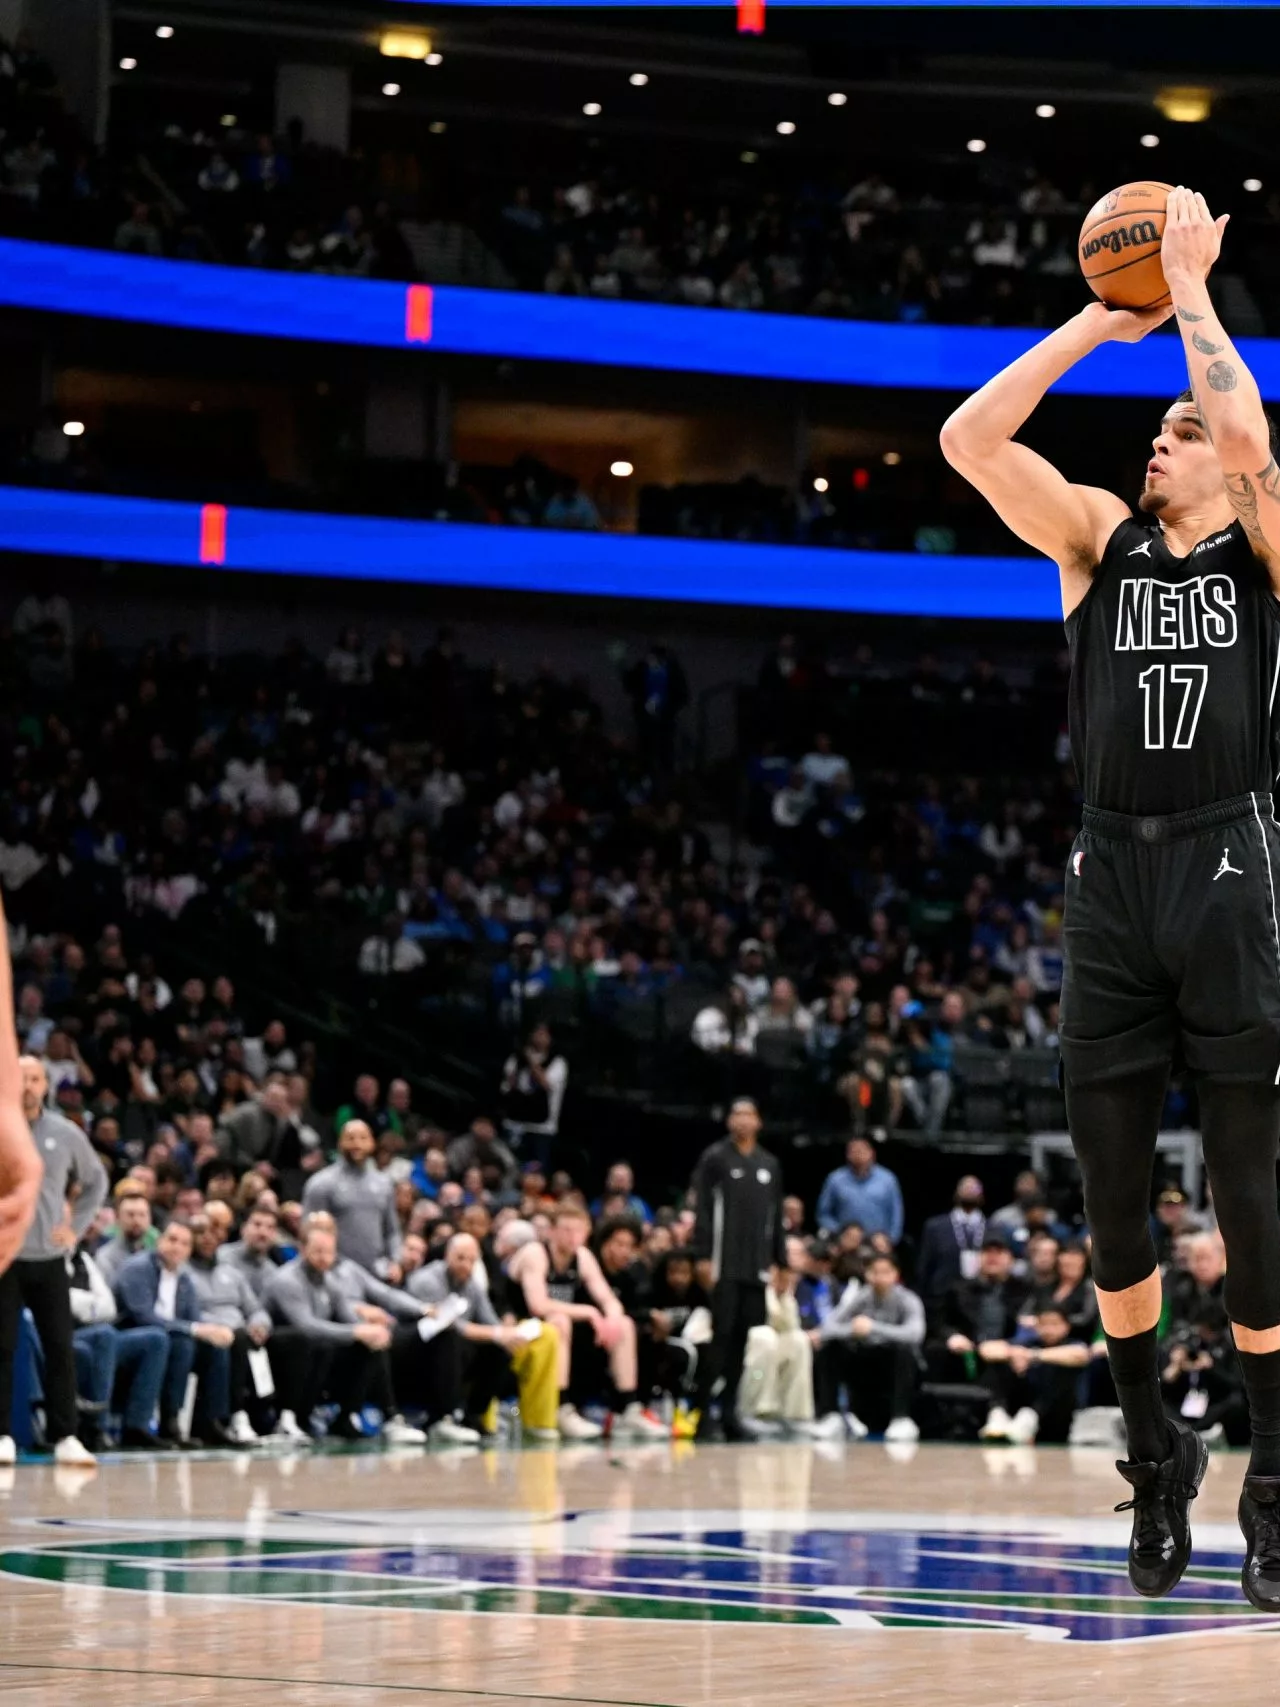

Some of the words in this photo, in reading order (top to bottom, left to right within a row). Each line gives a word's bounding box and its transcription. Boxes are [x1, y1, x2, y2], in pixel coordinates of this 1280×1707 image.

[1082, 221, 1161, 260] Wilson
[1195, 543, 1206, 554] All
[1206, 541, 1215, 549] In
[1214, 533, 1232, 545] Won
[1115, 574, 1237, 651] NETS
[1138, 664, 1208, 749] 17
